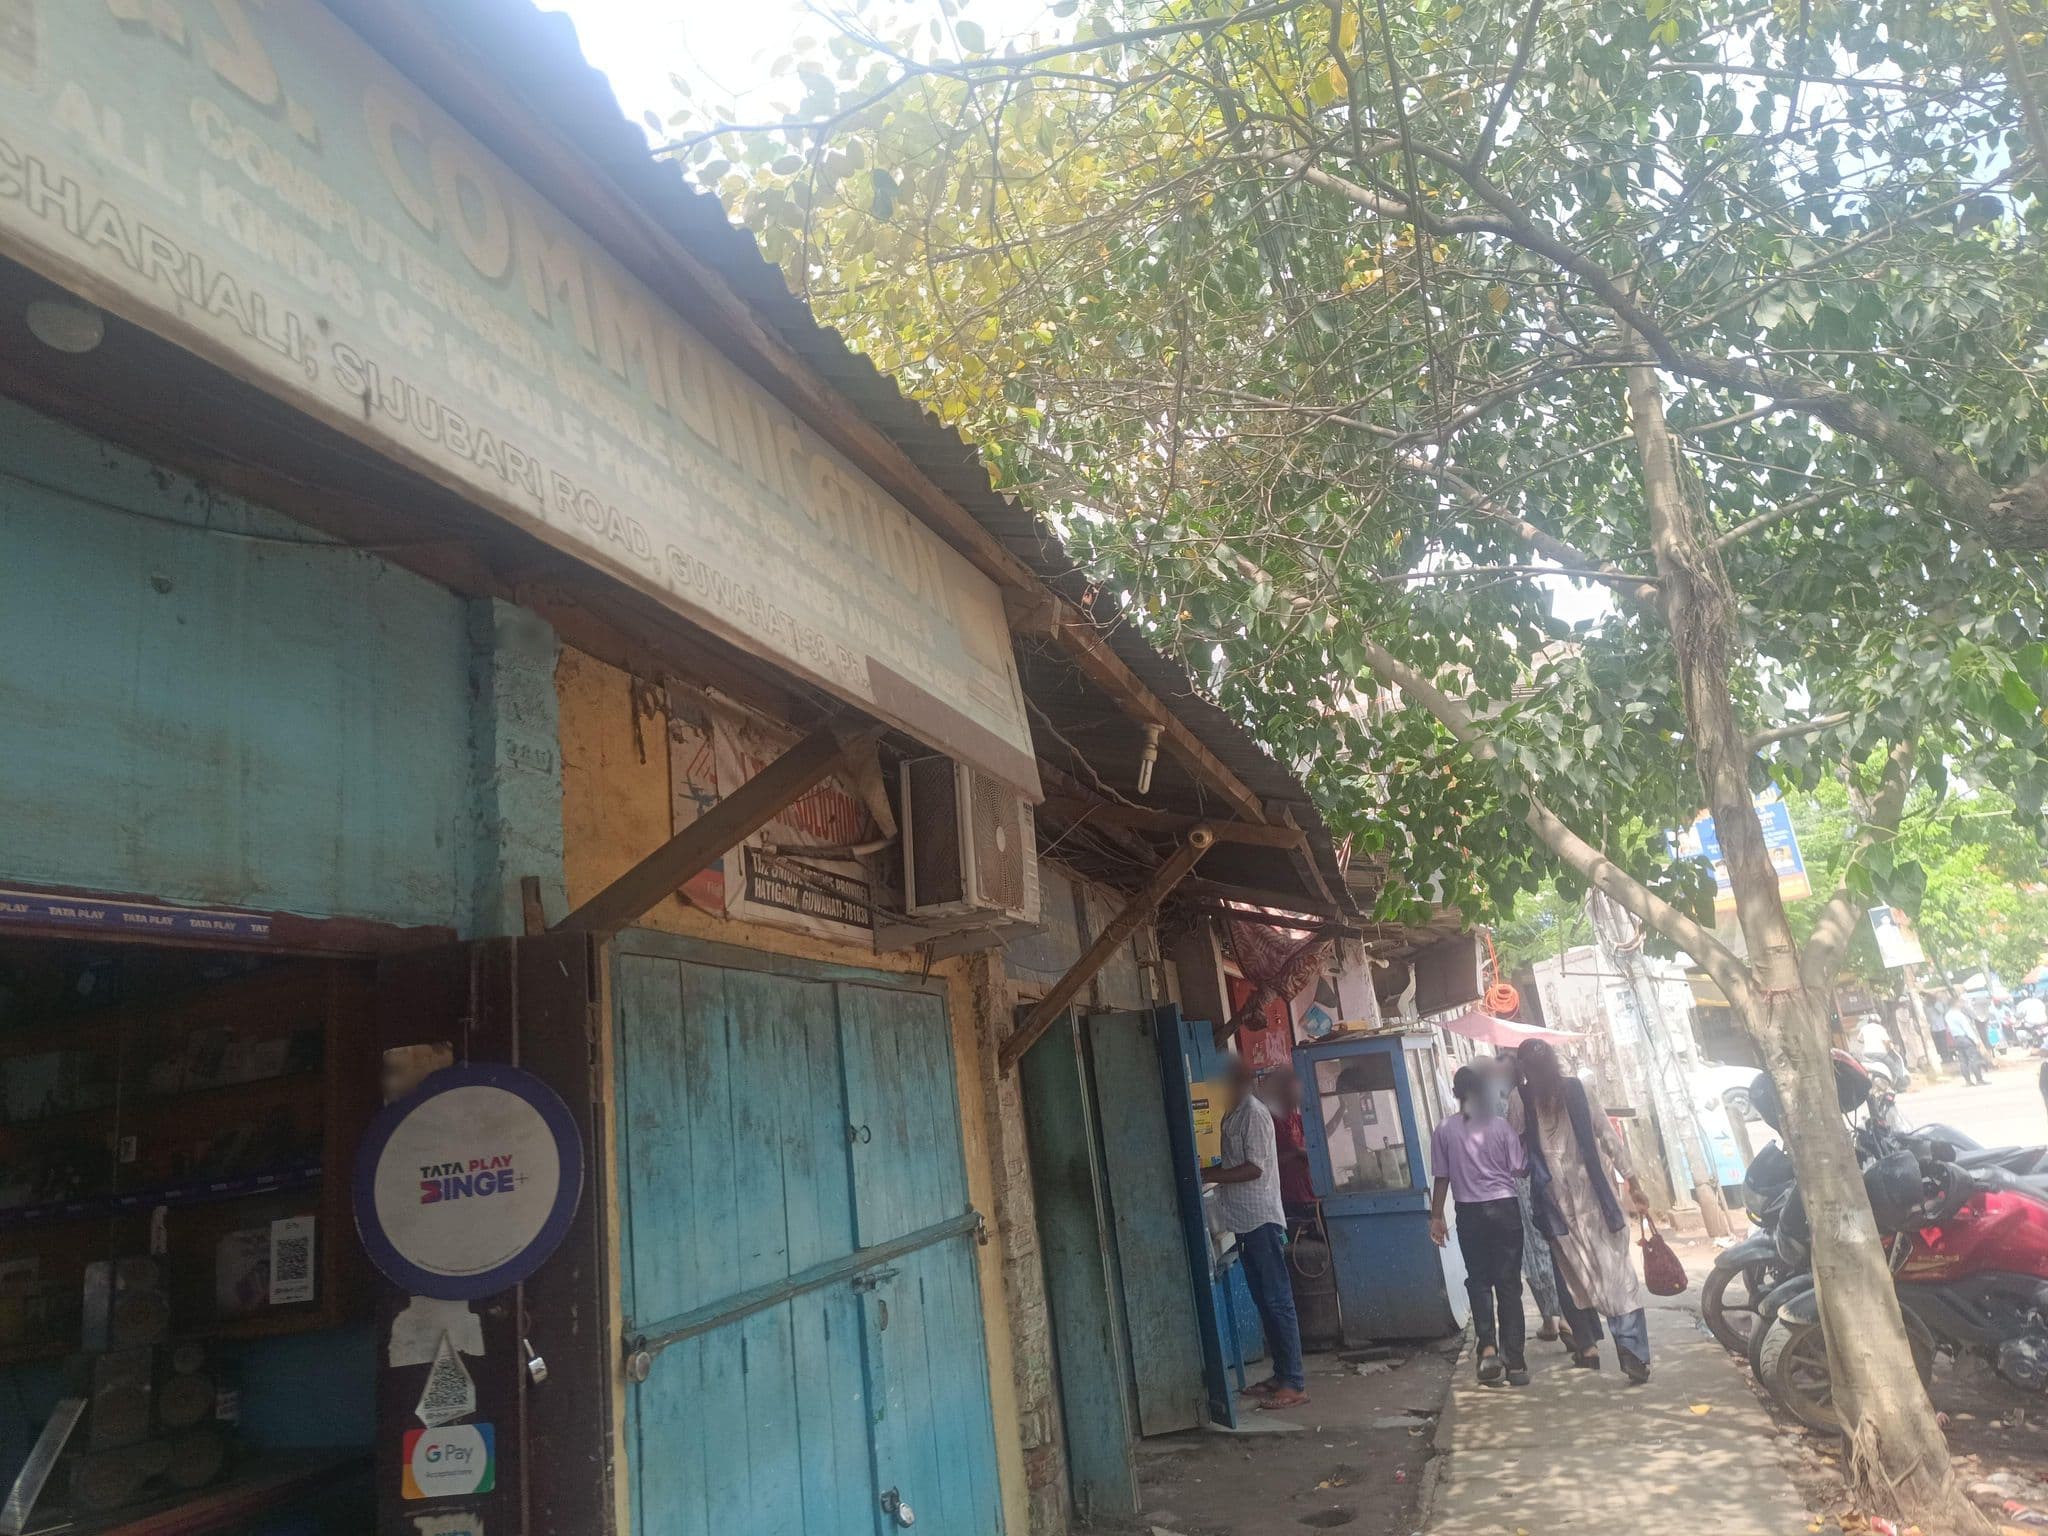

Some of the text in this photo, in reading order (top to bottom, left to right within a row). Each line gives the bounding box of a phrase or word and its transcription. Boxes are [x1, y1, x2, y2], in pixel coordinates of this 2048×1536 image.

[53, 76, 187, 208] ALL
[199, 166, 362, 324] KINDS
[373, 281, 438, 371] OF
[444, 329, 588, 465] MOBILE
[592, 428, 695, 532] PHONE
[362, 68, 952, 624] COMMUNICATION
[332, 340, 545, 503] SIJUBARI
[550, 469, 661, 576] ROAD,
[48, 906, 76, 917] TATA
[78, 909, 106, 920] PLAY
[123, 913, 148, 923] TATA
[149, 915, 174, 926] PLAY
[190, 919, 212, 928] TATA
[213, 921, 237, 930] PLAY
[420, 1154, 513, 1179] TATA PLAY
[445, 1444, 473, 1464] Pay
